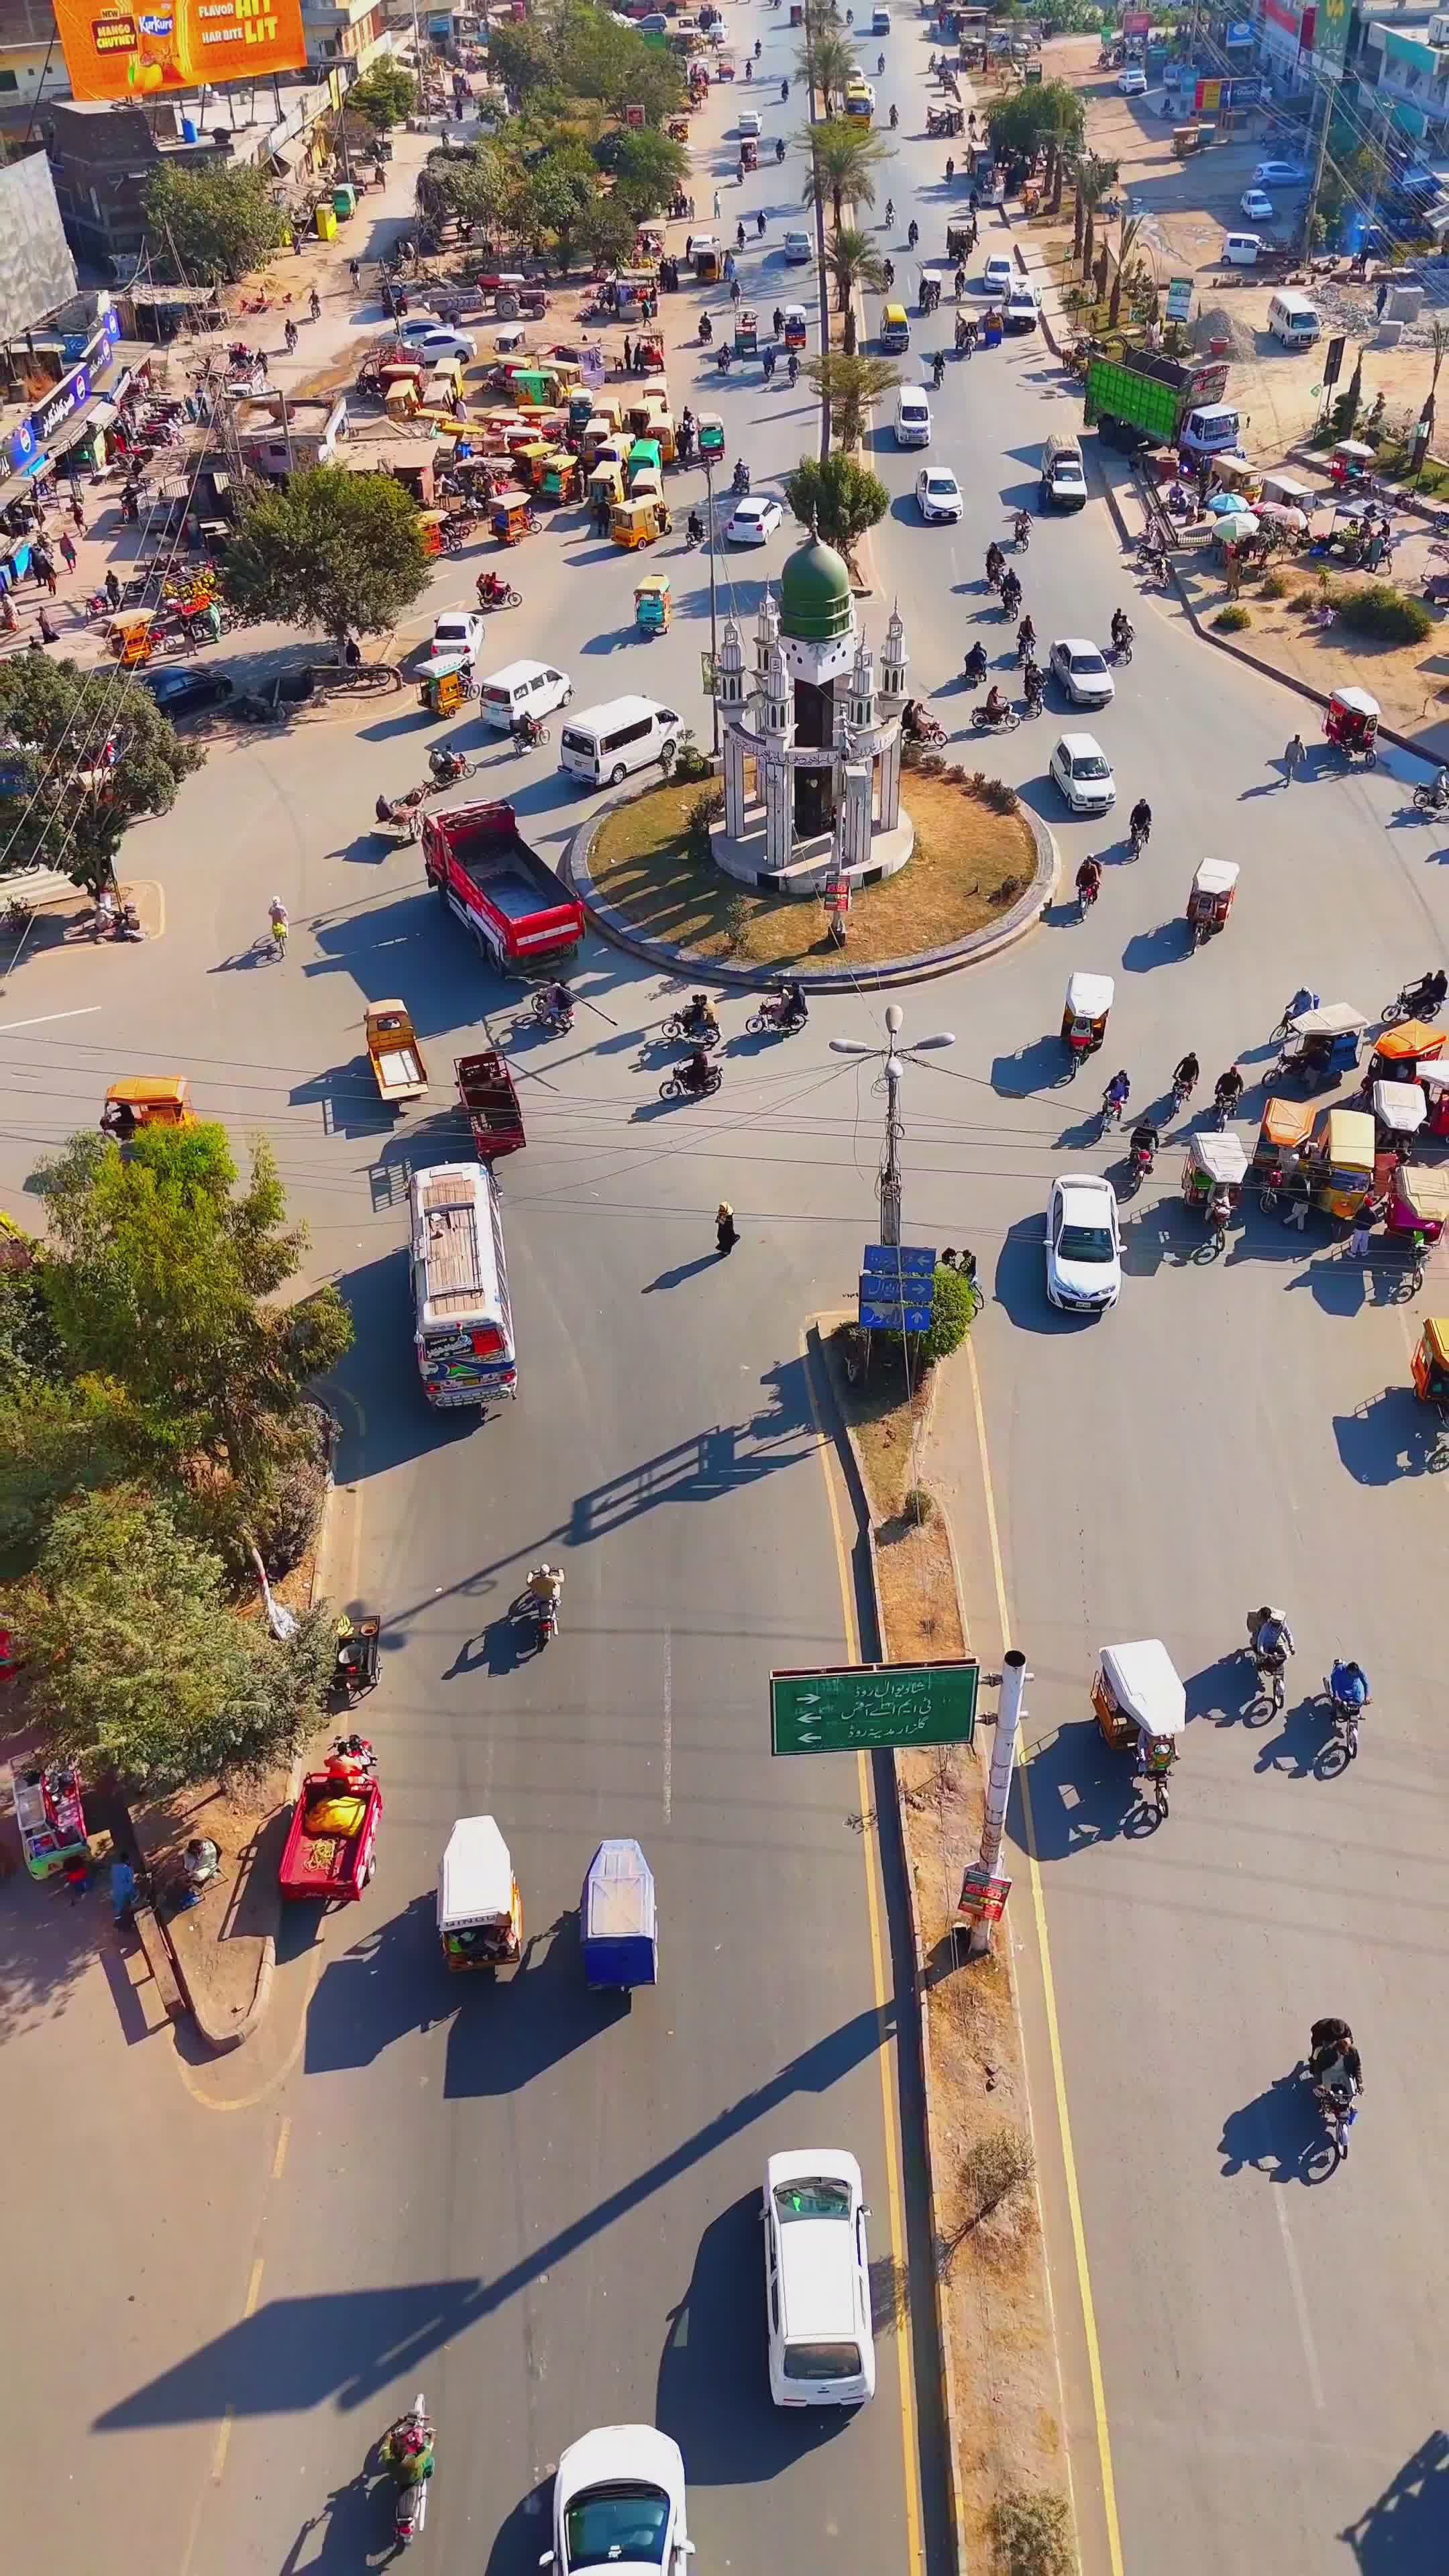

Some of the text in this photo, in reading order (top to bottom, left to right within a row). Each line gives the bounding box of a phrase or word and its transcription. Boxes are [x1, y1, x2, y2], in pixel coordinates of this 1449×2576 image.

[199, 3, 233, 18] FLAVOR
[97, 24, 130, 37] MANGO
[202, 16, 278, 44] HAR BITE LIT
[97, 34, 135, 48] CHUTNEY
